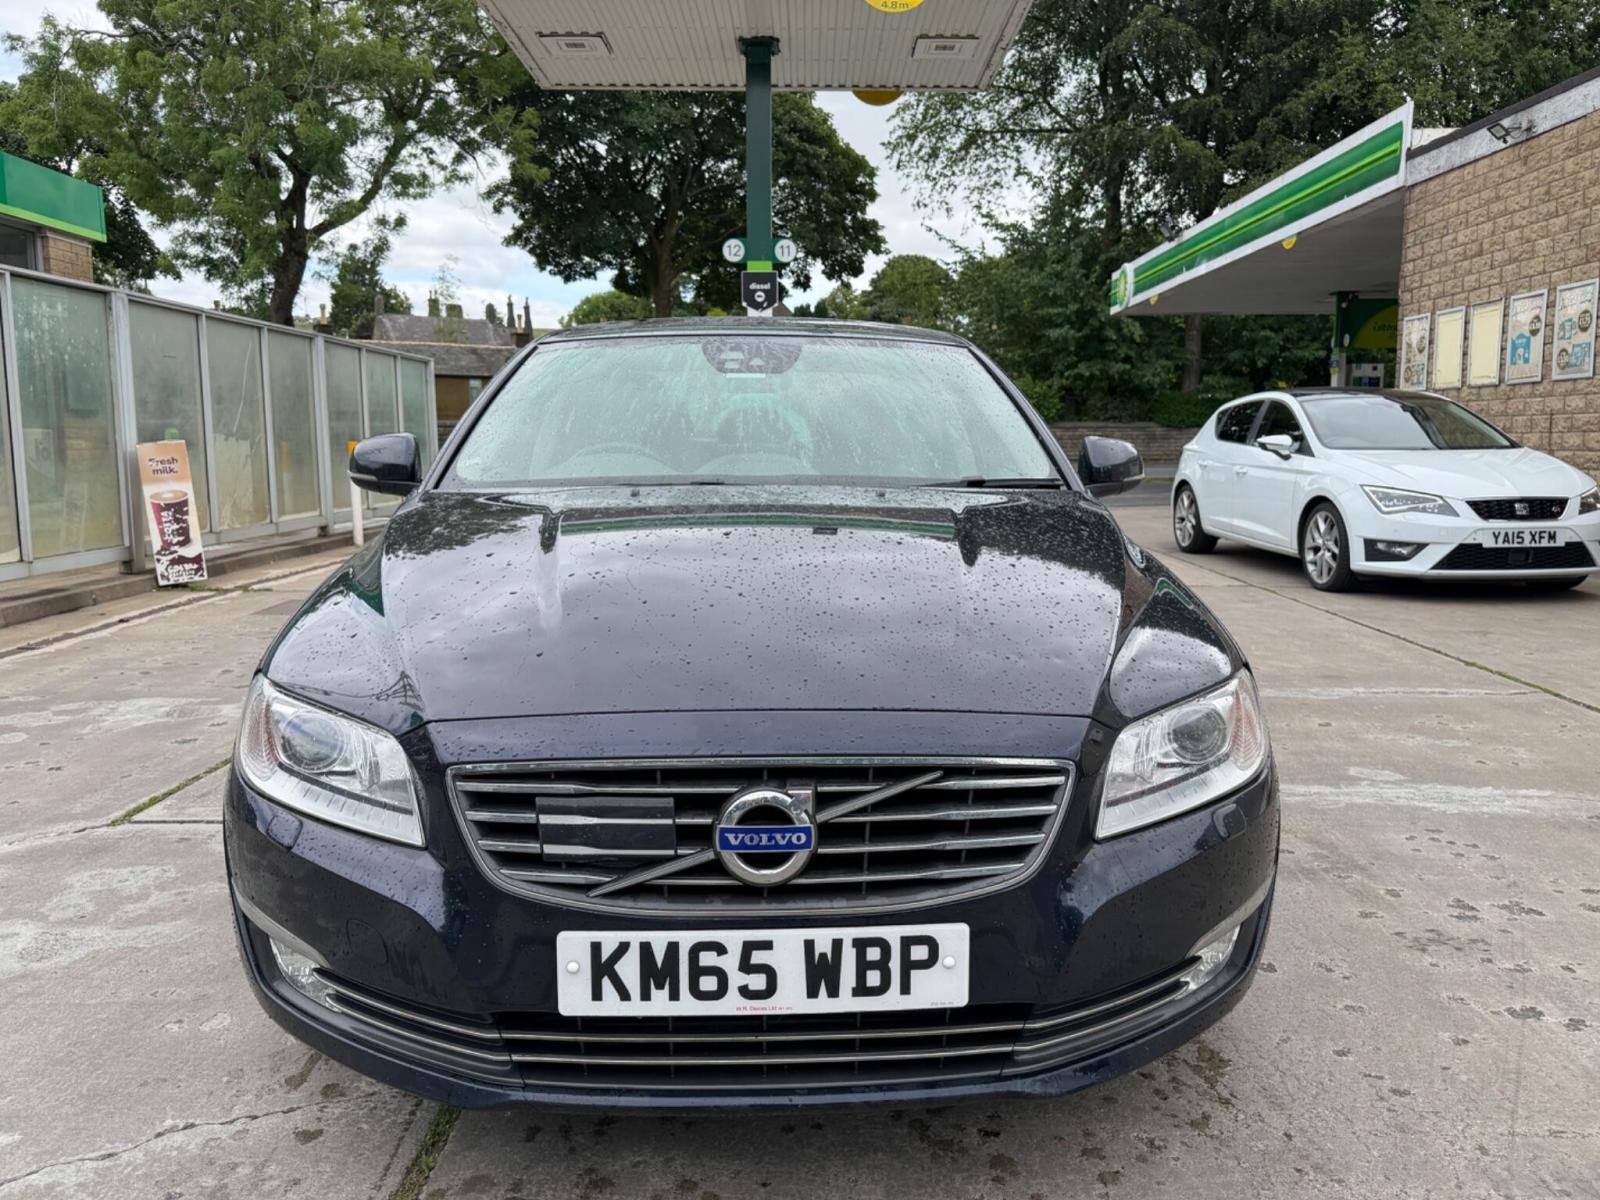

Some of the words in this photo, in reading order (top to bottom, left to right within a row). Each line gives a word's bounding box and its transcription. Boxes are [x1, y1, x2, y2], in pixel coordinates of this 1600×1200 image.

[726, 244, 742, 257] 12
[779, 244, 791, 257] 11
[1492, 531, 1525, 544] YA15
[1529, 531, 1557, 544] XFM
[724, 832, 807, 846] VOLVO
[590, 941, 778, 1002] KM65
[804, 935, 939, 999] WBP
